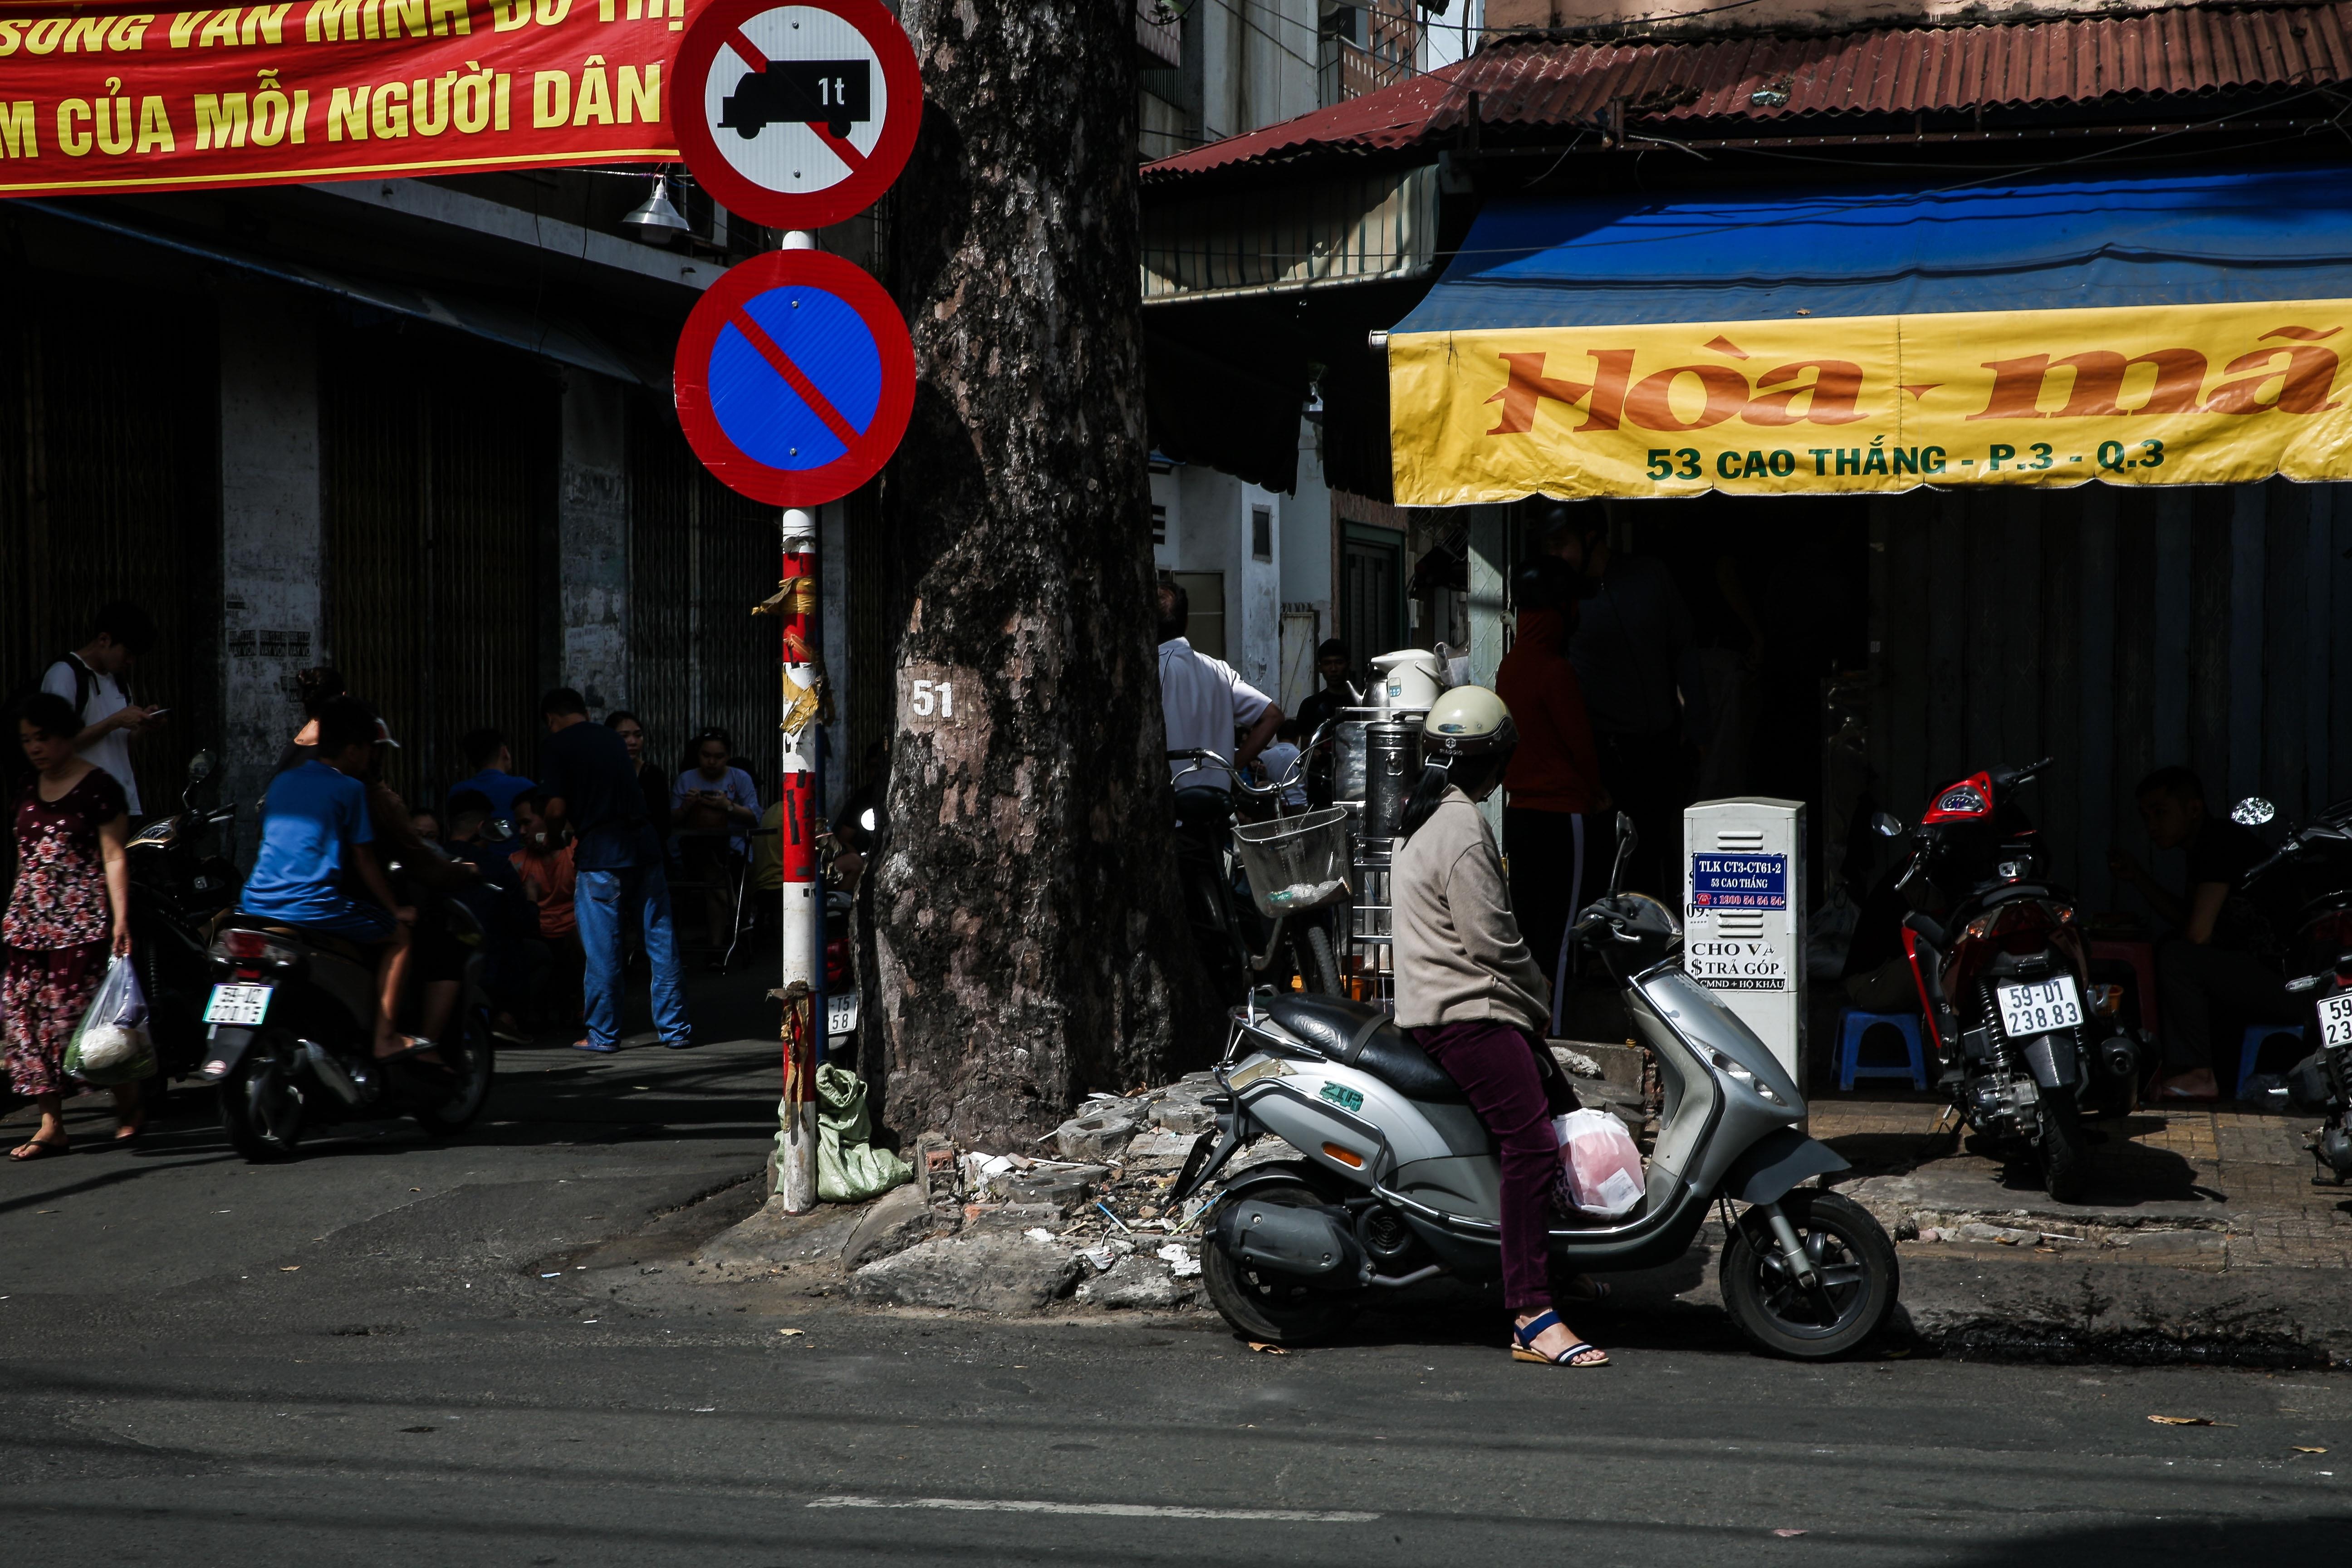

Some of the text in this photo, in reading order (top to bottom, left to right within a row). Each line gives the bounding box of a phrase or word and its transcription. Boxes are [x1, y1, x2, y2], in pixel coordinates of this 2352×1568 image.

[305, 0, 470, 42] MINH
[818, 78, 844, 105] 1t
[57, 77, 175, 157] CỦA
[194, 68, 309, 150] MỖI
[328, 60, 510, 141] NGƯỜI
[534, 54, 660, 128] DÂN
[1483, 335, 1870, 436] Hòa
[1965, 326, 2343, 420] mã
[1646, 448, 1702, 480] 53
[1716, 449, 1796, 479] CAO
[1808, 434, 1946, 476] THẮNG
[1989, 441, 2053, 470] P.3
[2097, 439, 2165, 473] Q.3
[913, 680, 952, 718] 51
[1699, 861, 1781, 873] TLK CT3-CT61-2
[1711, 878, 1719, 887] 53
[1721, 878, 1738, 888] CAO
[1719, 895, 1741, 904] 1900
[1743, 895, 1754, 905] 54
[1757, 896, 1769, 905] 54
[1770, 896, 1783, 906] 54
[1691, 943, 1740, 956] CHO
[1705, 958, 1740, 974] TRẢ
[1744, 959, 1779, 975] GÓP
[1700, 980, 1730, 988] CMND
[2008, 1002, 2078, 1034] 238.83
[2329, 999, 2352, 1020] 59
[2326, 1020, 2352, 1044] 23
